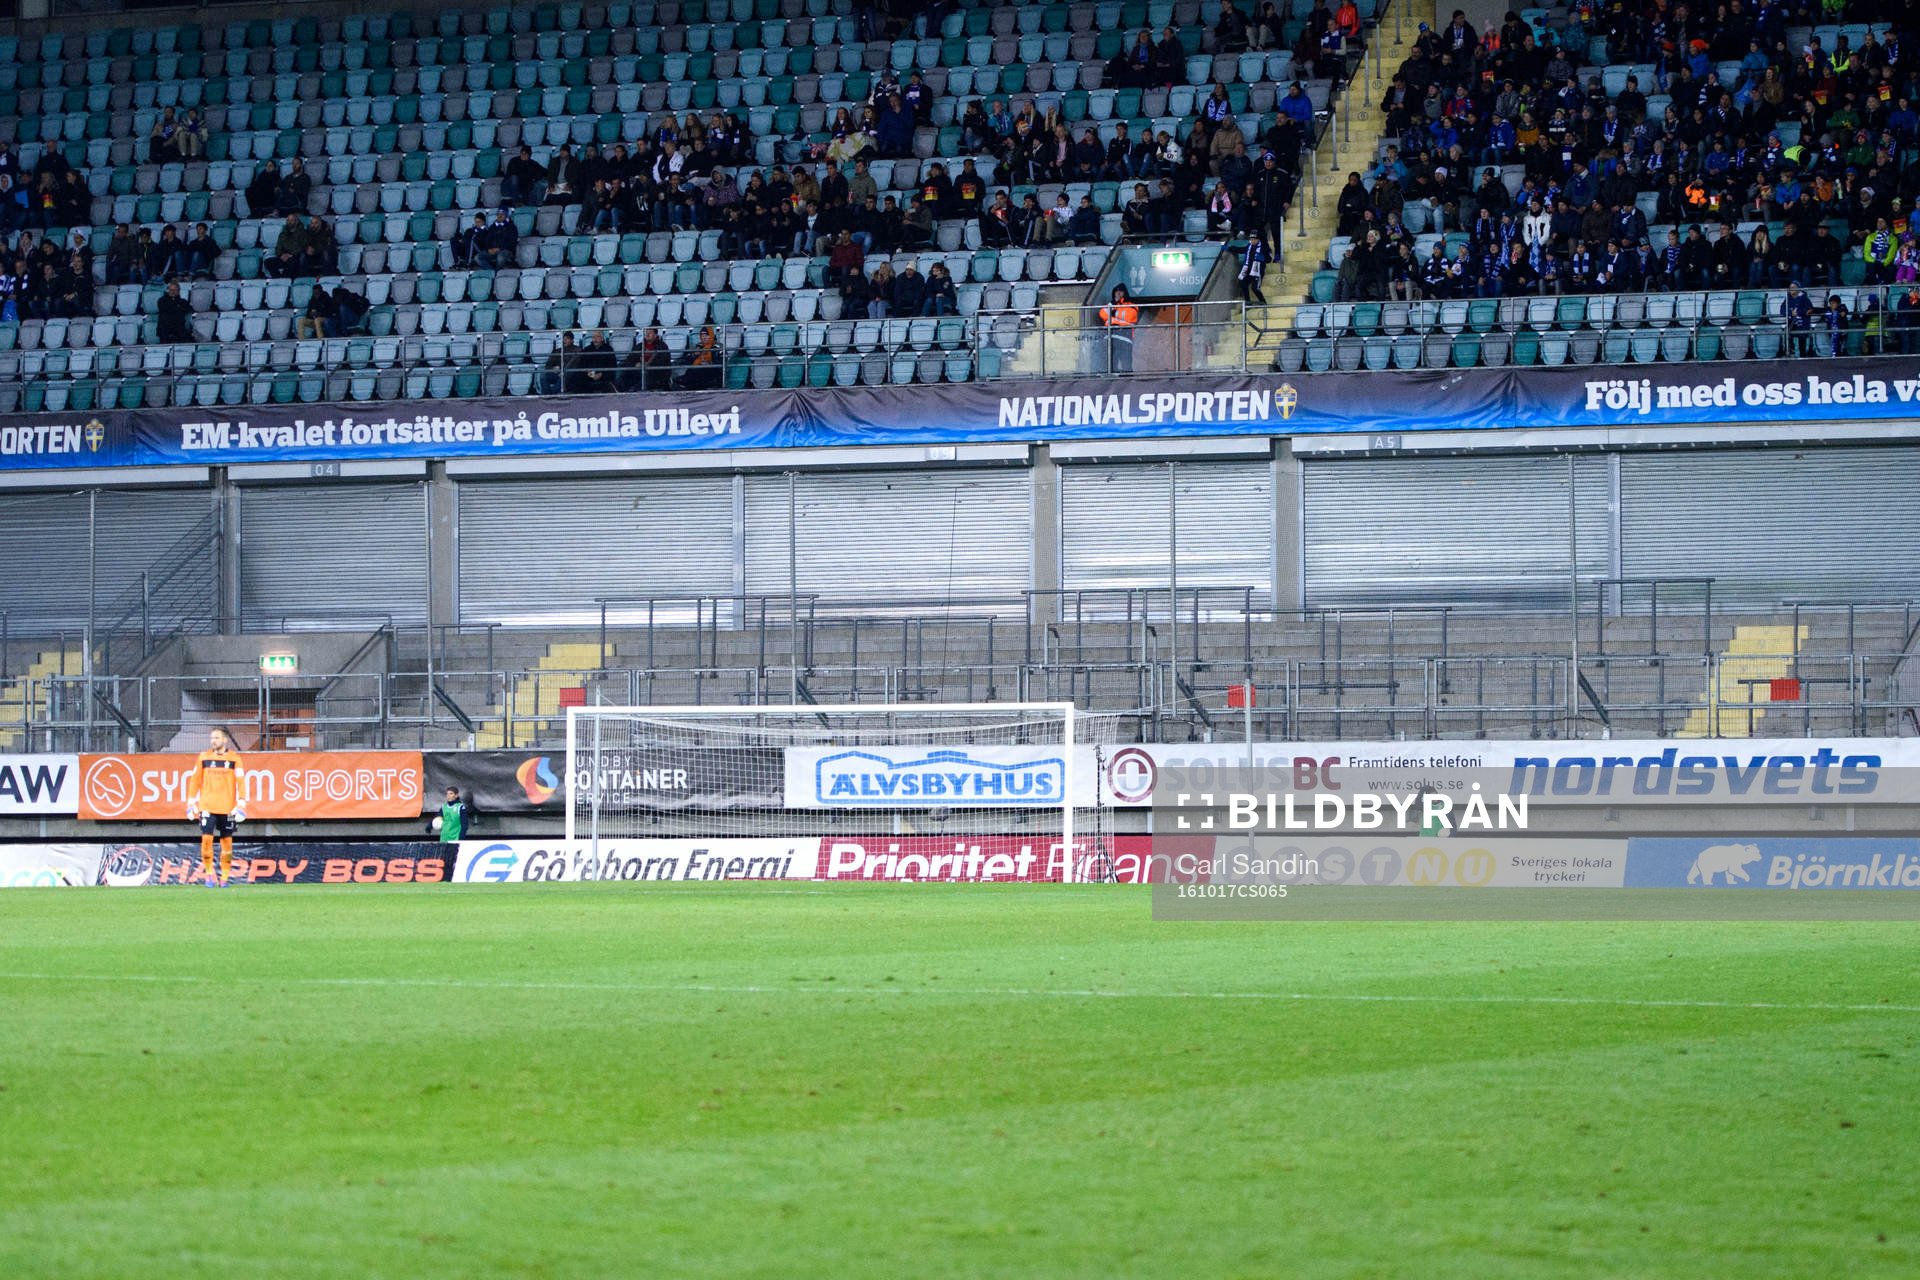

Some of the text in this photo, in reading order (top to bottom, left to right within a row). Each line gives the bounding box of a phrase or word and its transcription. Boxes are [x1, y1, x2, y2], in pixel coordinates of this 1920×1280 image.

[998, 389, 1271, 428] NATIONALSPORTEN
[1585, 377, 1652, 415] Följ
[1657, 377, 1737, 409] med
[1742, 382, 1802, 407] oss
[1807, 374, 1889, 404] hela
[0, 425, 81, 455] ORTEN
[181, 406, 741, 450] EM-kvalet fortsätter på Gamla Ullevi
[1349, 755, 1482, 768] Framtidens telefoni
[1509, 748, 1881, 796] nordsvets
[282, 768, 418, 801] SPORTS
[828, 773, 1054, 796] ÄLVSBYHUS
[1368, 777, 1464, 790] www.solus.se
[322, 857, 446, 883] BOSS
[828, 843, 1037, 878] Prioritet
[1511, 856, 1613, 869] Sveriges lokala
[1534, 871, 1586, 884] tryckeri
